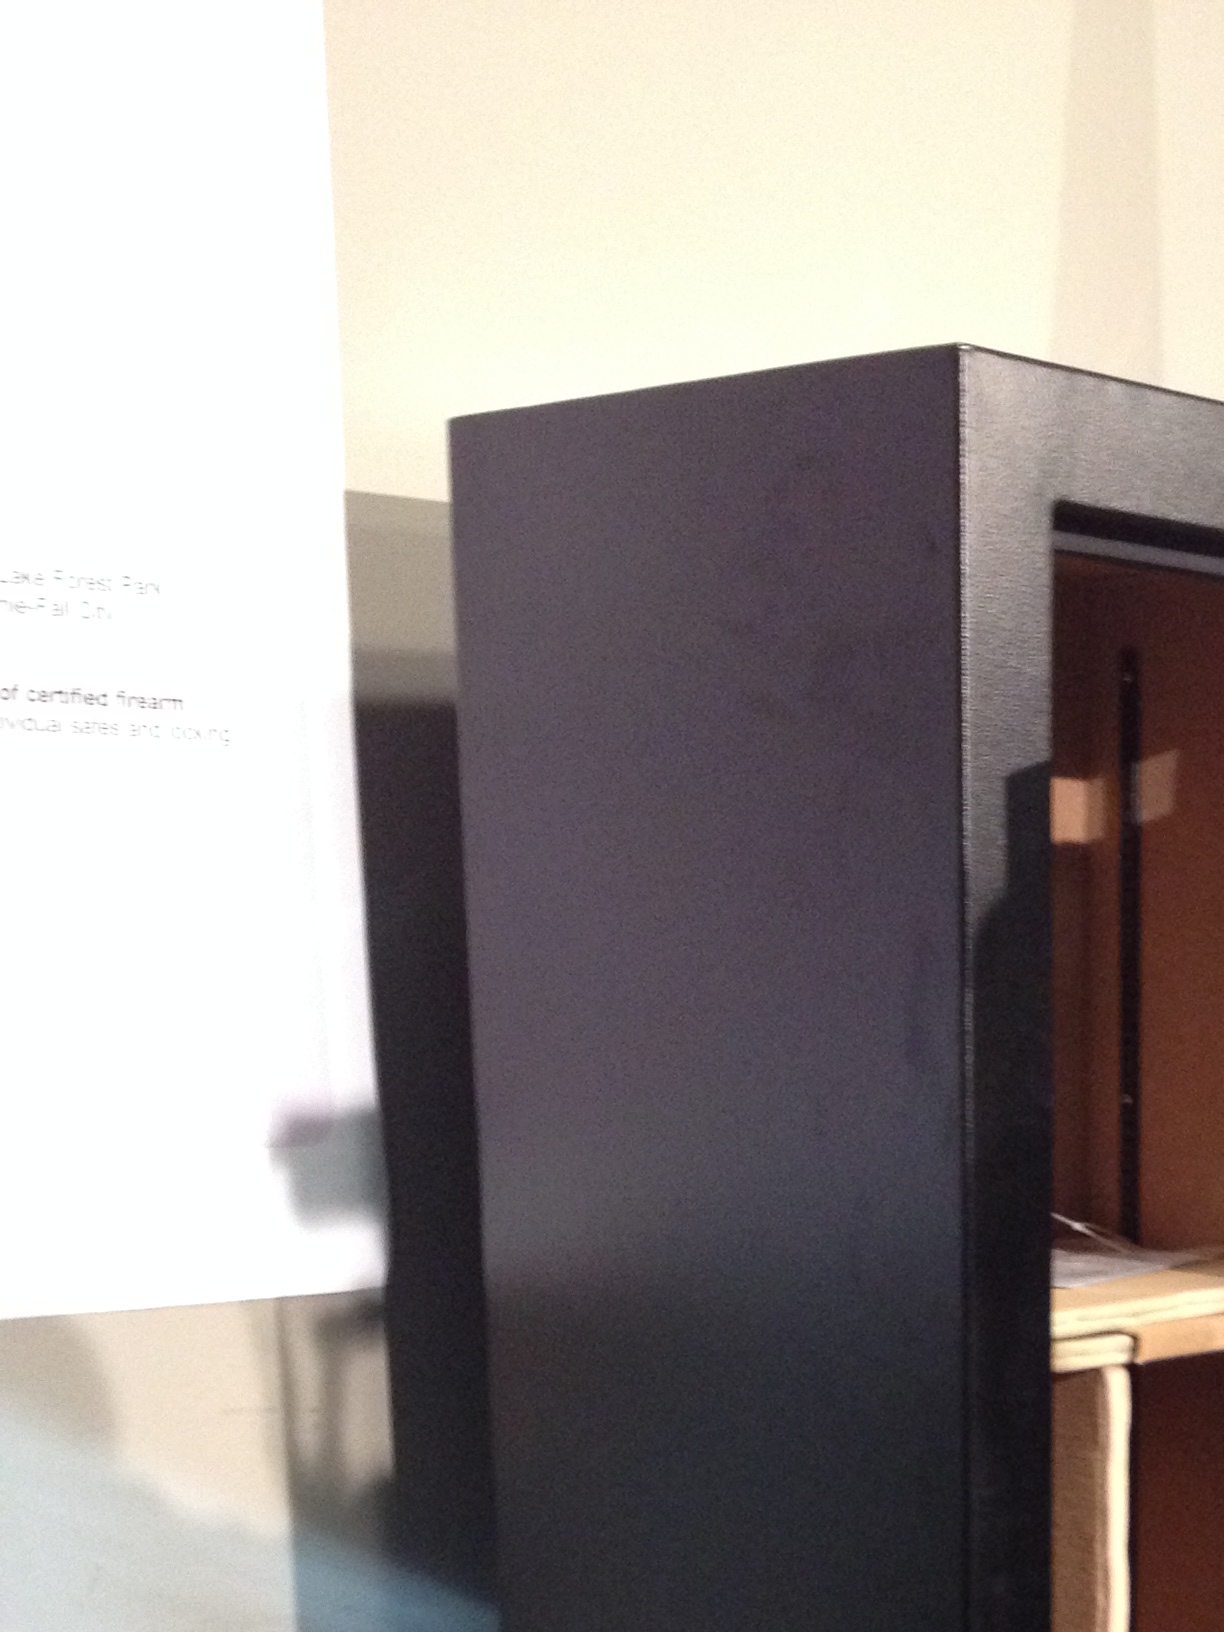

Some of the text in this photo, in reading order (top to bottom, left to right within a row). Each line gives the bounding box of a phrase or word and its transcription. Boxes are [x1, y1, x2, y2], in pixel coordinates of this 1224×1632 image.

[0, 683, 184, 711] of certified firearm
